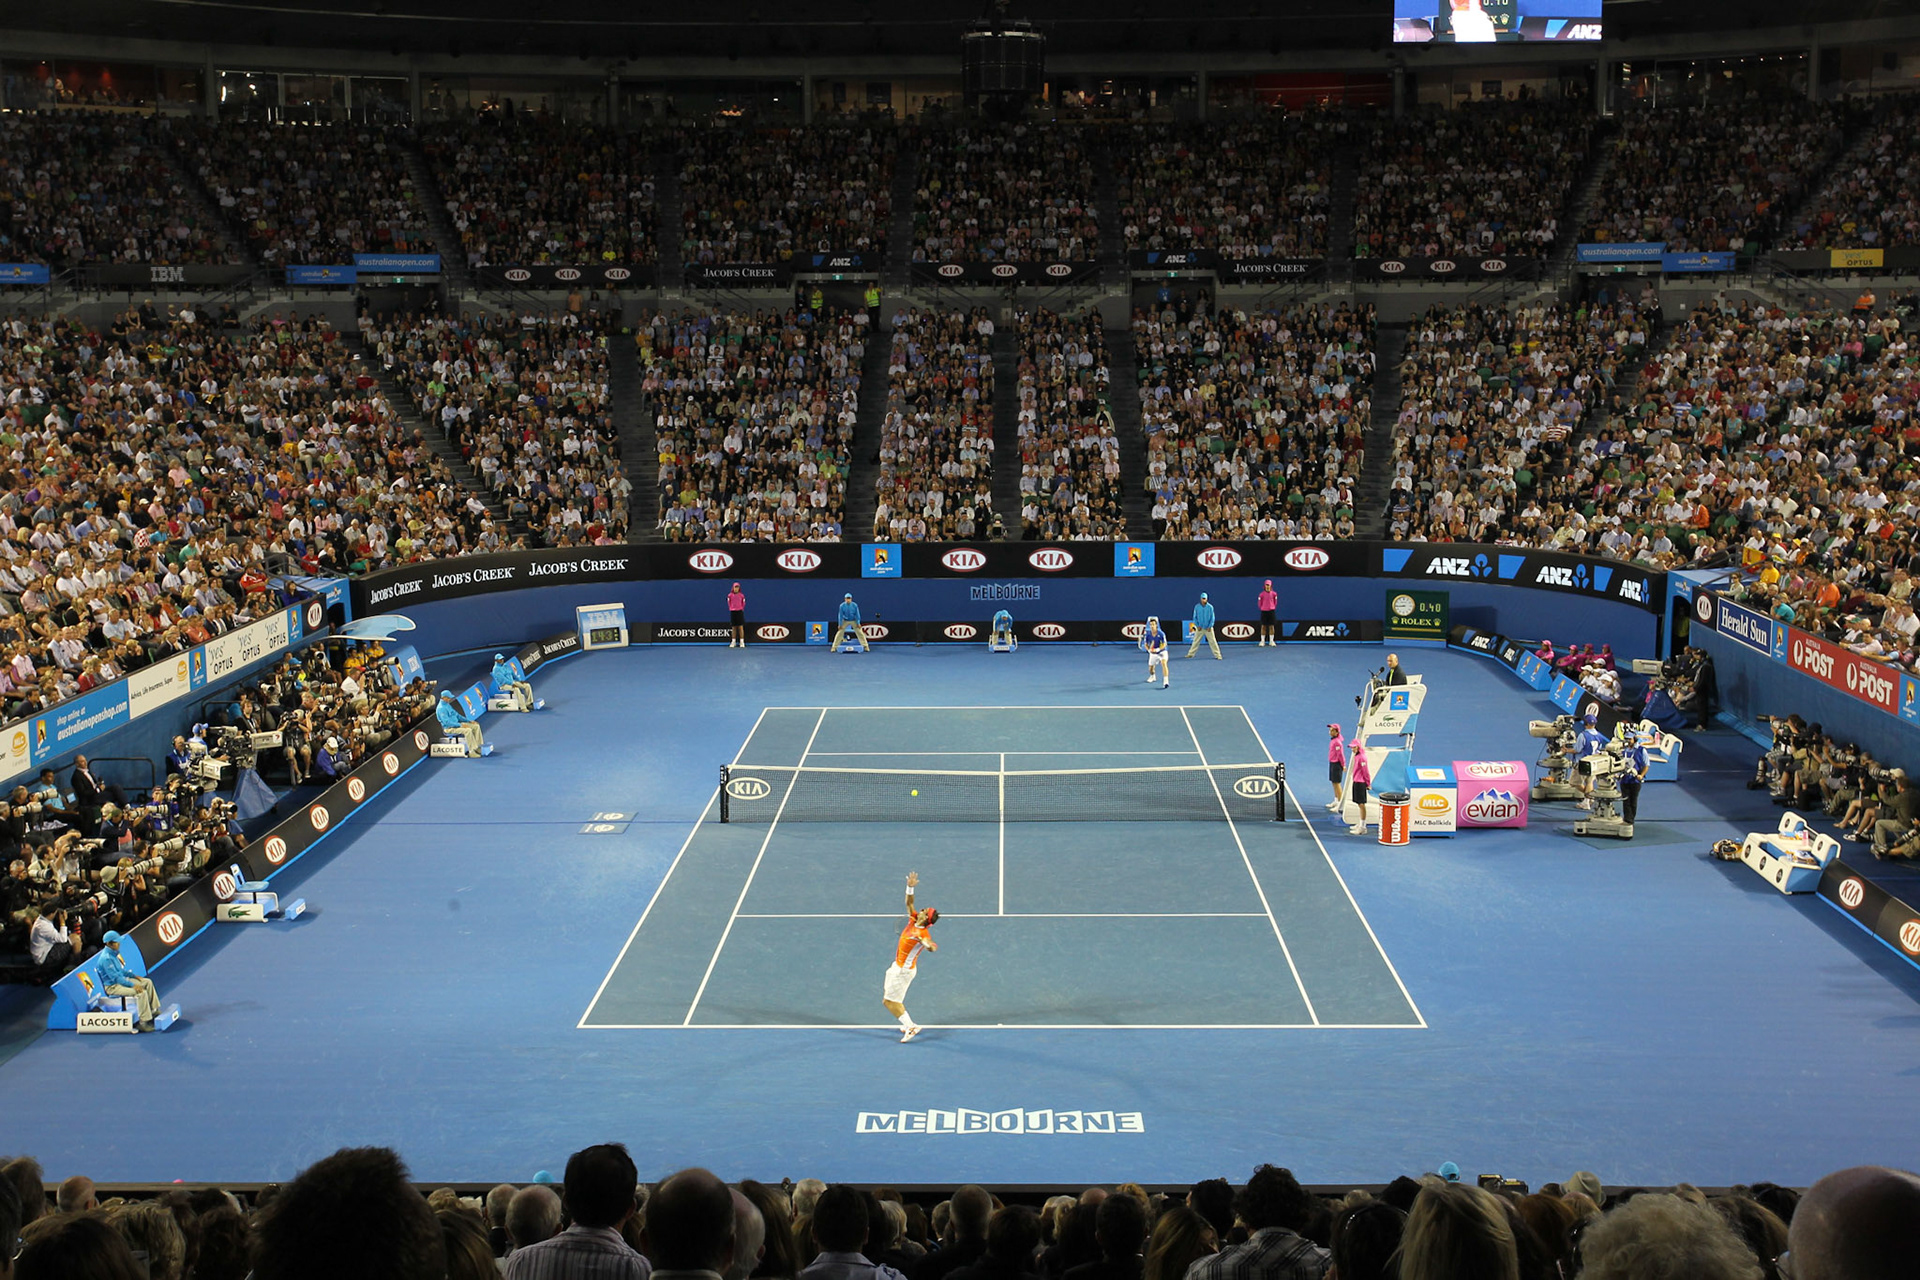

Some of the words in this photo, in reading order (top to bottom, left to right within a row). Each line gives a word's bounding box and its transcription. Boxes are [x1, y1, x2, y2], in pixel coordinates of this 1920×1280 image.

[1567, 24, 1602, 40] ANZ
[1165, 255, 1186, 264] ANZ
[1582, 247, 1660, 259] australianopen.com
[358, 258, 435, 268] australianopen.com
[829, 258, 851, 266] ANZ
[1234, 263, 1271, 274] JACOB'S
[1272, 263, 1306, 273] CREEK
[1384, 263, 1402, 271] KIA
[1434, 262, 1452, 270] KIA
[1484, 262, 1503, 270] KIA
[150, 267, 184, 282] IBM
[508, 270, 528, 280] KIA
[559, 270, 578, 279] KIA
[608, 270, 628, 278] KIA
[703, 268, 740, 278] JACOB'S
[742, 268, 775, 278] CREEK
[941, 266, 961, 274] KIA
[994, 266, 1014, 274] KIA
[1049, 266, 1068, 274] KIA
[697, 555, 728, 568] KIA
[784, 554, 814, 567] KIA
[950, 554, 980, 566] KIA
[1036, 554, 1066, 566] KIA
[1204, 553, 1234, 565] KIA
[1292, 552, 1322, 565] KIA
[528, 562, 578, 576] JACOB'S
[580, 558, 627, 572] CREEK
[1426, 557, 1470, 576] ANZ
[432, 572, 472, 589] JACOB'S
[472, 568, 514, 583] CREEK
[1536, 566, 1572, 587] ANZ
[370, 586, 394, 605] JACOB'S
[394, 580, 422, 598] CREEK
[971, 584, 1040, 600] MELBOURNE
[1619, 579, 1642, 602] ANZ
[1420, 602, 1441, 612] 0.40
[1699, 600, 1710, 617] KIA
[310, 606, 320, 624] KIA
[587, 610, 620, 628] IBM
[1400, 618, 1432, 626] ROLEX
[1721, 606, 1749, 638] Herald
[1750, 619, 1767, 646] Sun
[592, 630, 613, 642] 143
[658, 628, 696, 638] JACOB'S
[697, 628, 731, 638] CREEK
[762, 628, 784, 637] KIA
[950, 627, 972, 636] KIA
[1038, 627, 1060, 636] KIA
[1228, 626, 1250, 636] KIA
[1306, 626, 1335, 637] ANZ
[268, 632, 286, 649] OPTUS
[1471, 636, 1490, 650] ANZ
[242, 644, 260, 662] OPTUS
[214, 656, 233, 675] OPTUS
[1804, 647, 1834, 680] POST
[1859, 670, 1893, 706] POST
[56, 716, 67, 726] shop
[67, 710, 80, 721] online
[80, 706, 86, 716] at
[57, 701, 128, 742] australianopenshop.com
[416, 732, 429, 750] KIA
[384, 755, 398, 774] KIA
[1470, 764, 1515, 775] evian
[350, 780, 364, 799] KIA
[734, 782, 763, 795] KIA
[1242, 780, 1272, 793] KIA
[1422, 799, 1444, 808] MLC
[1467, 801, 1518, 819] evian
[312, 808, 328, 828] KIA
[1391, 808, 1402, 843] Wilson
[267, 840, 286, 862] KIA
[216, 876, 236, 898] KIA
[1841, 882, 1859, 905] KIA
[160, 916, 182, 940] KIA
[80, 1018, 129, 1028] LACOSTE
[858, 1109, 1143, 1132] MELBOURNE
